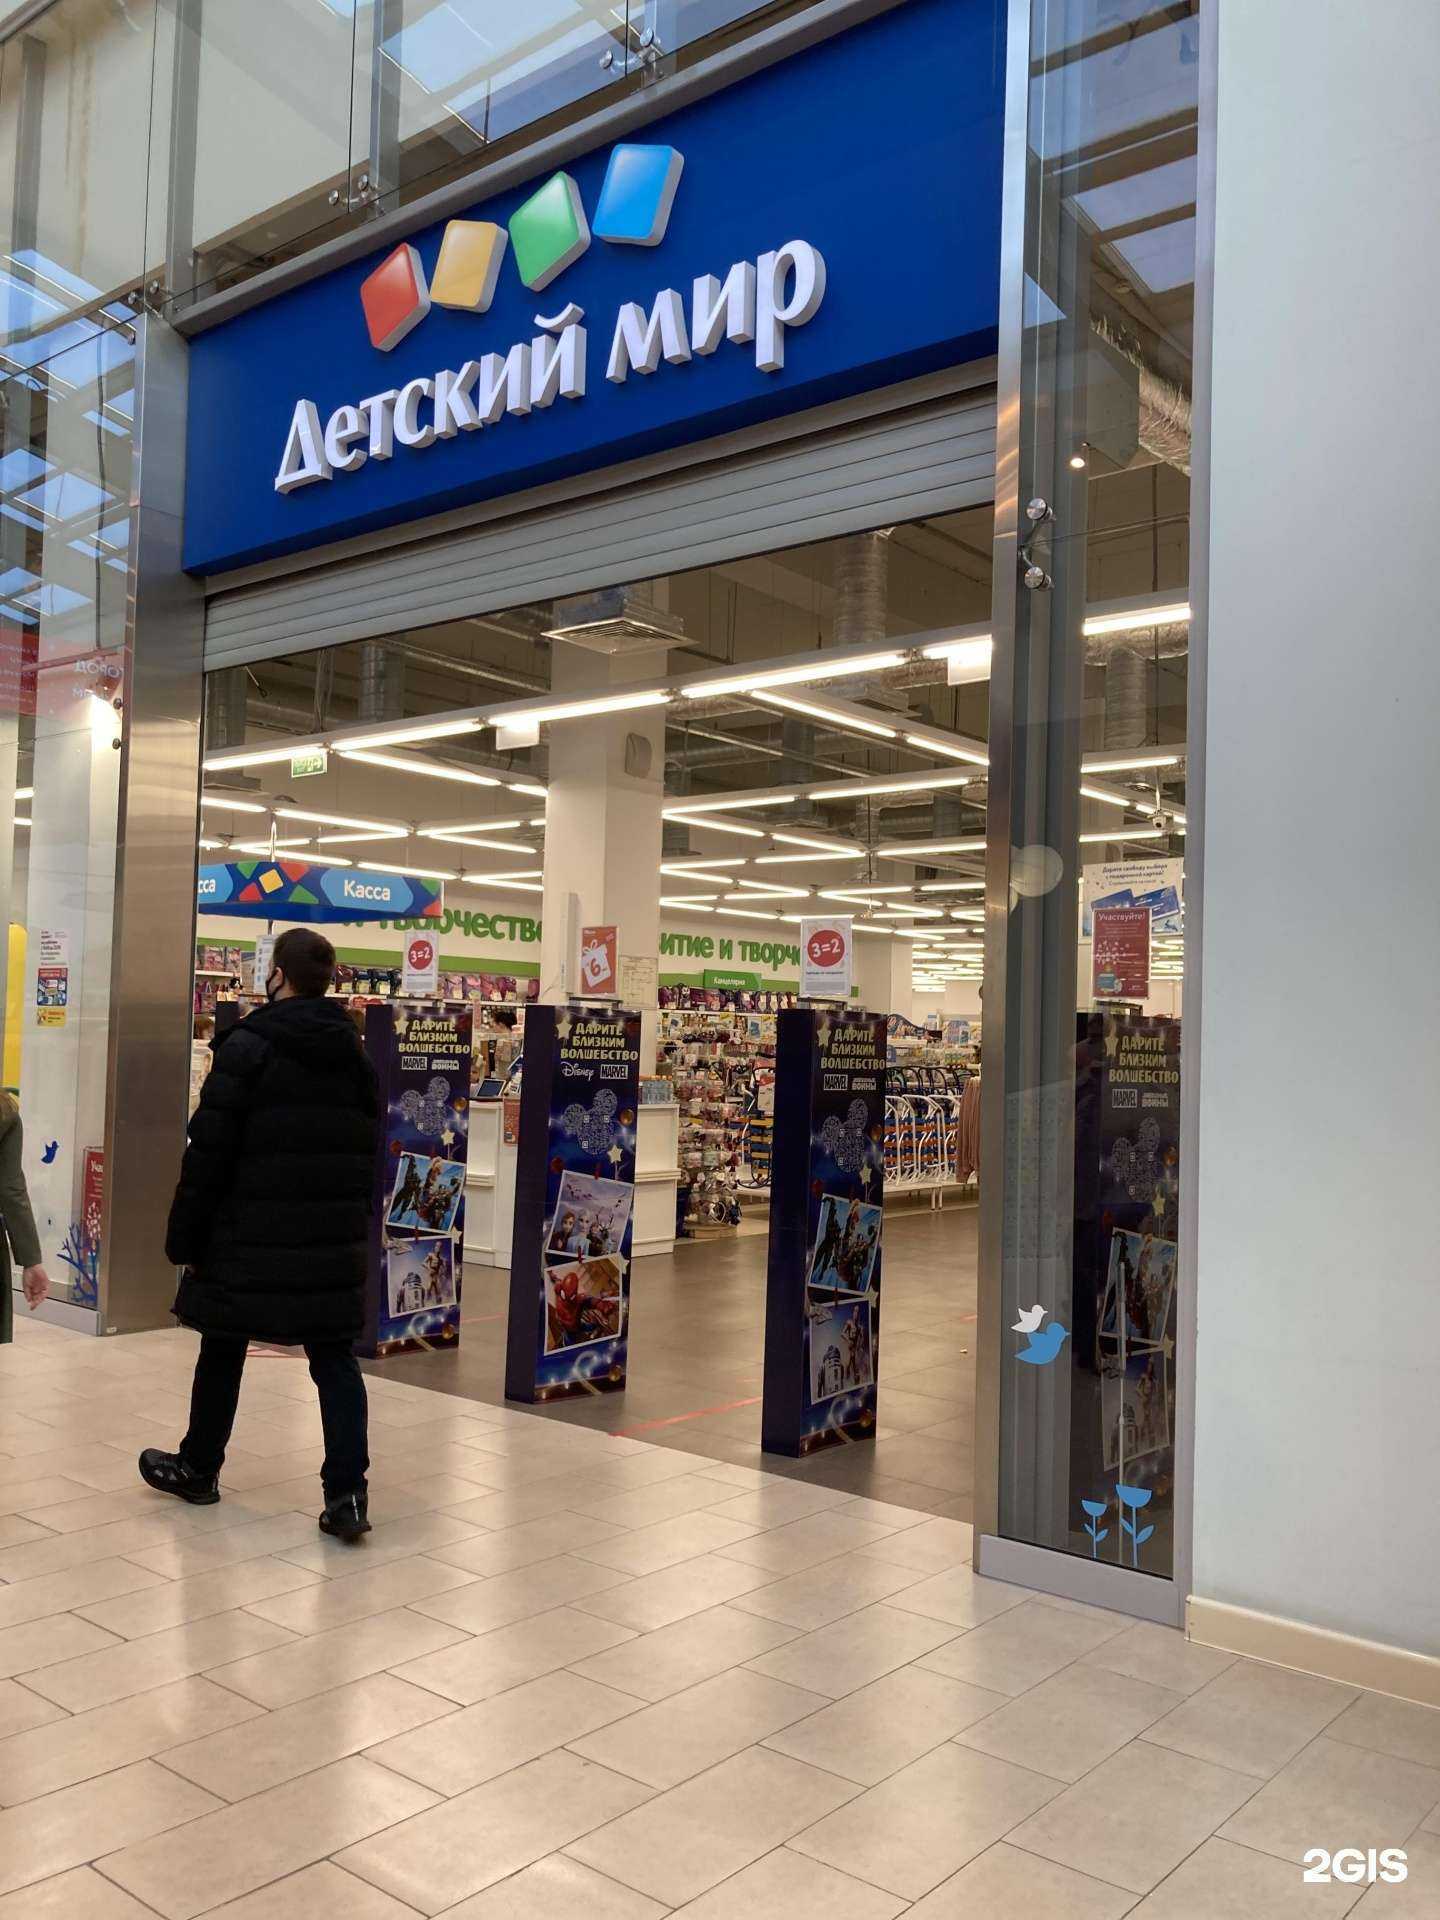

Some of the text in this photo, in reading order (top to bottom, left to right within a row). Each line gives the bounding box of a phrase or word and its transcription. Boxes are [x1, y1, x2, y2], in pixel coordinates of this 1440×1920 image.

[274, 240, 826, 494] Детский мир
[343, 879, 391, 902] Касса
[411, 946, 432, 962] 3=2
[720, 939, 733, 960] и
[807, 938, 841, 958] 3=2
[411, 1019, 455, 1031] ДАРИТЕ
[575, 1022, 623, 1035] ДАРИТЕ
[409, 1031, 458, 1042] БЛИЗКИМ
[572, 1036, 625, 1048] БЛИЗКИМ
[834, 1028, 874, 1043] ДАРИТЕ
[1121, 1035, 1165, 1051] ДАРИТЕ
[398, 1043, 470, 1053] ВОЛШЕБСТВО
[560, 1049, 639, 1061] ВОЛШЕБСТВО
[831, 1043, 876, 1056] БЛИЗКИМ
[402, 1056, 427, 1070] MARVEL
[820, 1056, 886, 1070] ВОЛШЕБСТВО
[1119, 1053, 1167, 1068] БЛИЗКИМ
[600, 1064, 628, 1079] MARVEL
[1109, 1069, 1179, 1084] ВОЛШЕБСТВО
